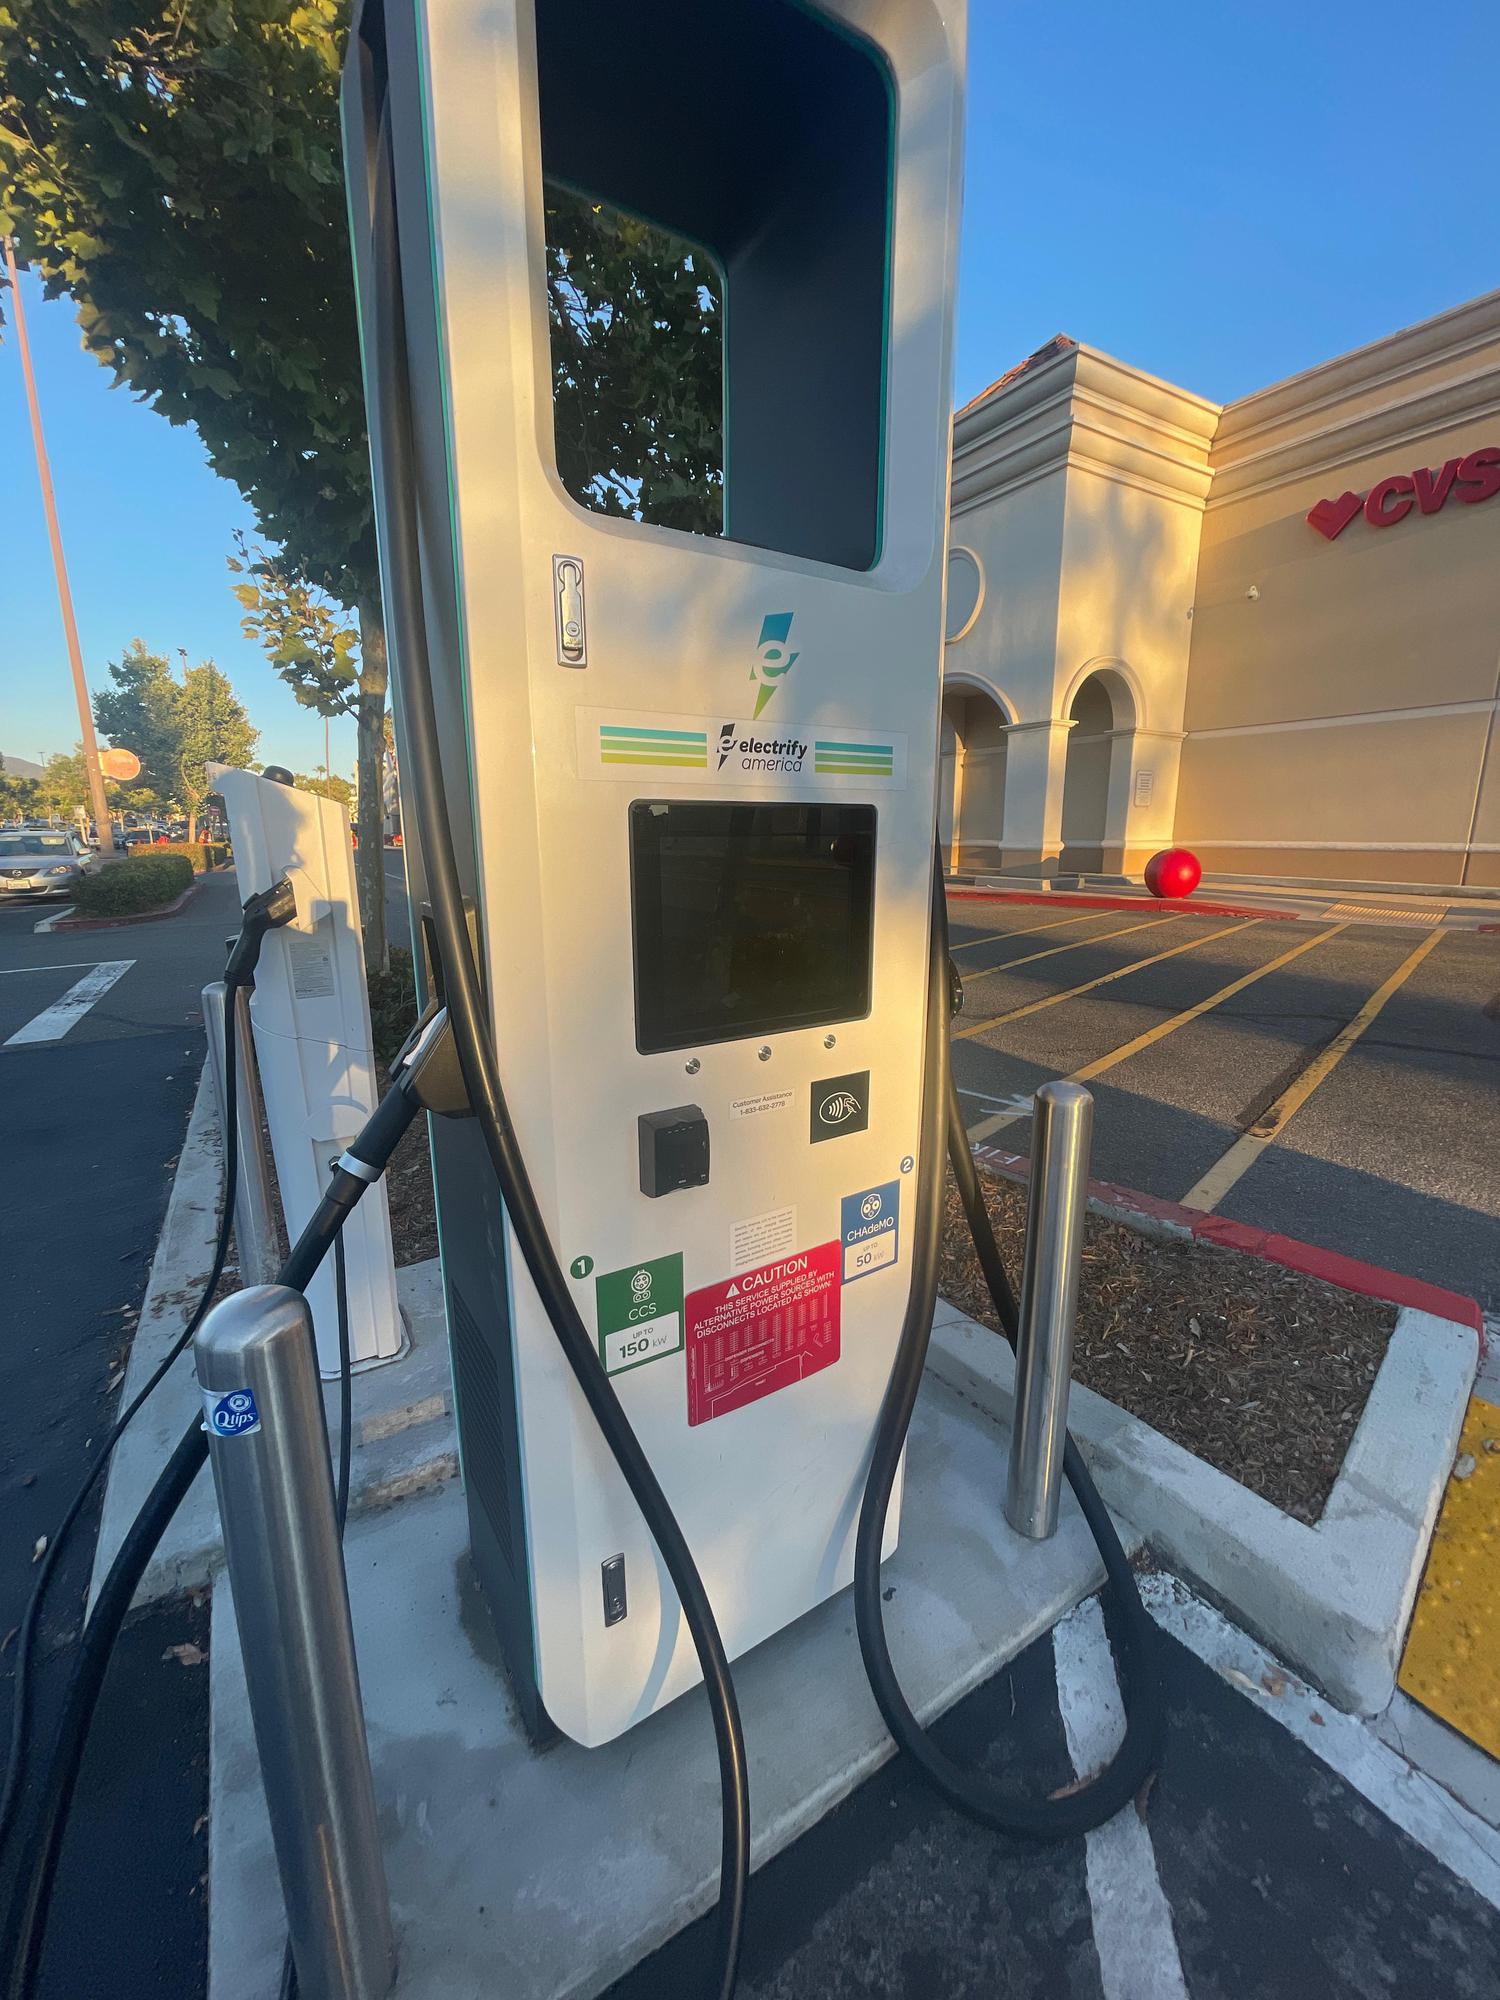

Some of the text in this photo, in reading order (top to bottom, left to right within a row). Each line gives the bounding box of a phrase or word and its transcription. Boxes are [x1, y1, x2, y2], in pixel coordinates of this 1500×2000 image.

[1364, 446, 1500, 527] CVS
[740, 738, 808, 759] electrify
[741, 755, 803, 773] america
[732, 1090, 793, 1109] Customer Assistance
[902, 1158, 912, 1172] 2
[846, 1216, 894, 1242] CHAdeMO
[856, 1252, 872, 1268] 50
[741, 1256, 809, 1291] CAUTION
[693, 1271, 835, 1331] ALTERNATIVE POWER SOURCES WITH
[714, 1269, 818, 1314] THIS SERVICE SUPPLIED BY
[628, 1302, 657, 1321] CCS
[696, 1280, 832, 1339] DISCONNECTS LOCATED AS SHOWN:
[632, 1326, 654, 1339] UP TO
[619, 1335, 668, 1359] 150 kW
